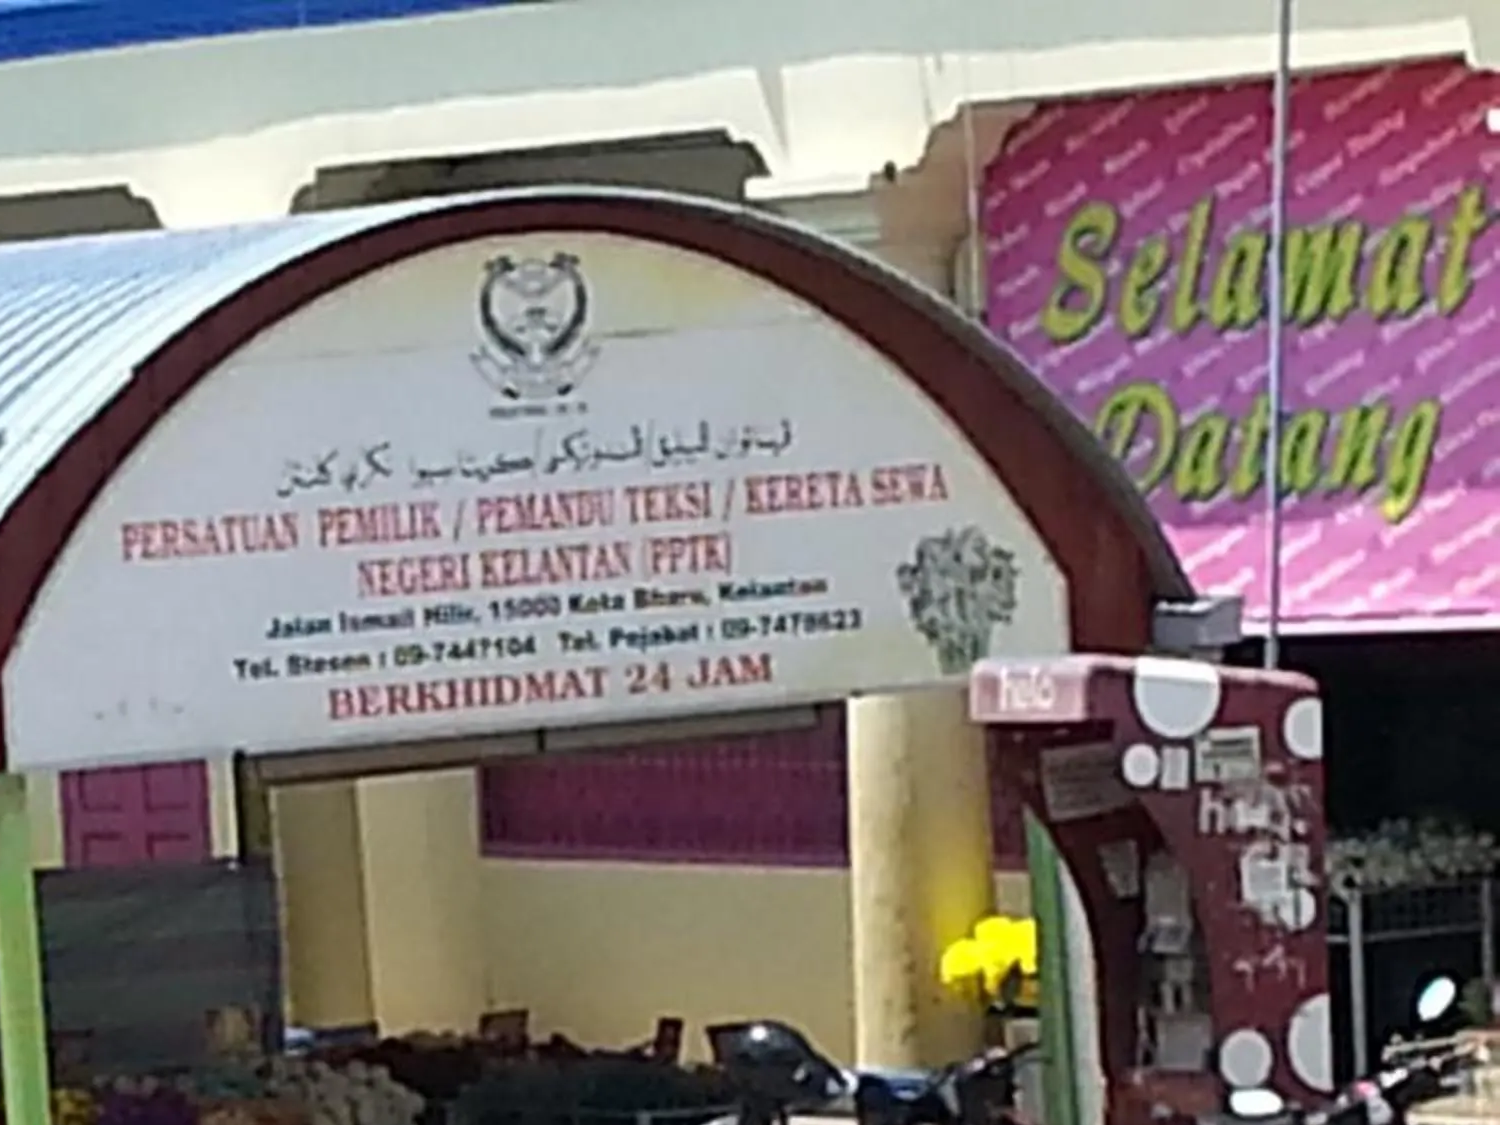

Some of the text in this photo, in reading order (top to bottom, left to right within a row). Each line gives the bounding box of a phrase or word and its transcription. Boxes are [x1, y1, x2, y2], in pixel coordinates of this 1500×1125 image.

[1041, 184, 1491, 345] Selamat
[1092, 380, 1442, 525] Datang
[121, 512, 299, 562] PERSATUAN
[319, 501, 442, 547] PEMILIK
[476, 487, 616, 535] PEMANDU
[626, 480, 713, 524] TEKSI
[744, 470, 864, 515] KERETA
[871, 463, 950, 504] SEWA
[357, 552, 471, 597] NEGERI
[480, 541, 632, 588] KELANTAN
[265, 617, 332, 640] Jalan
[568, 591, 625, 613] Kota
[327, 652, 774, 721] BERKHIDMAT 24 JAM
